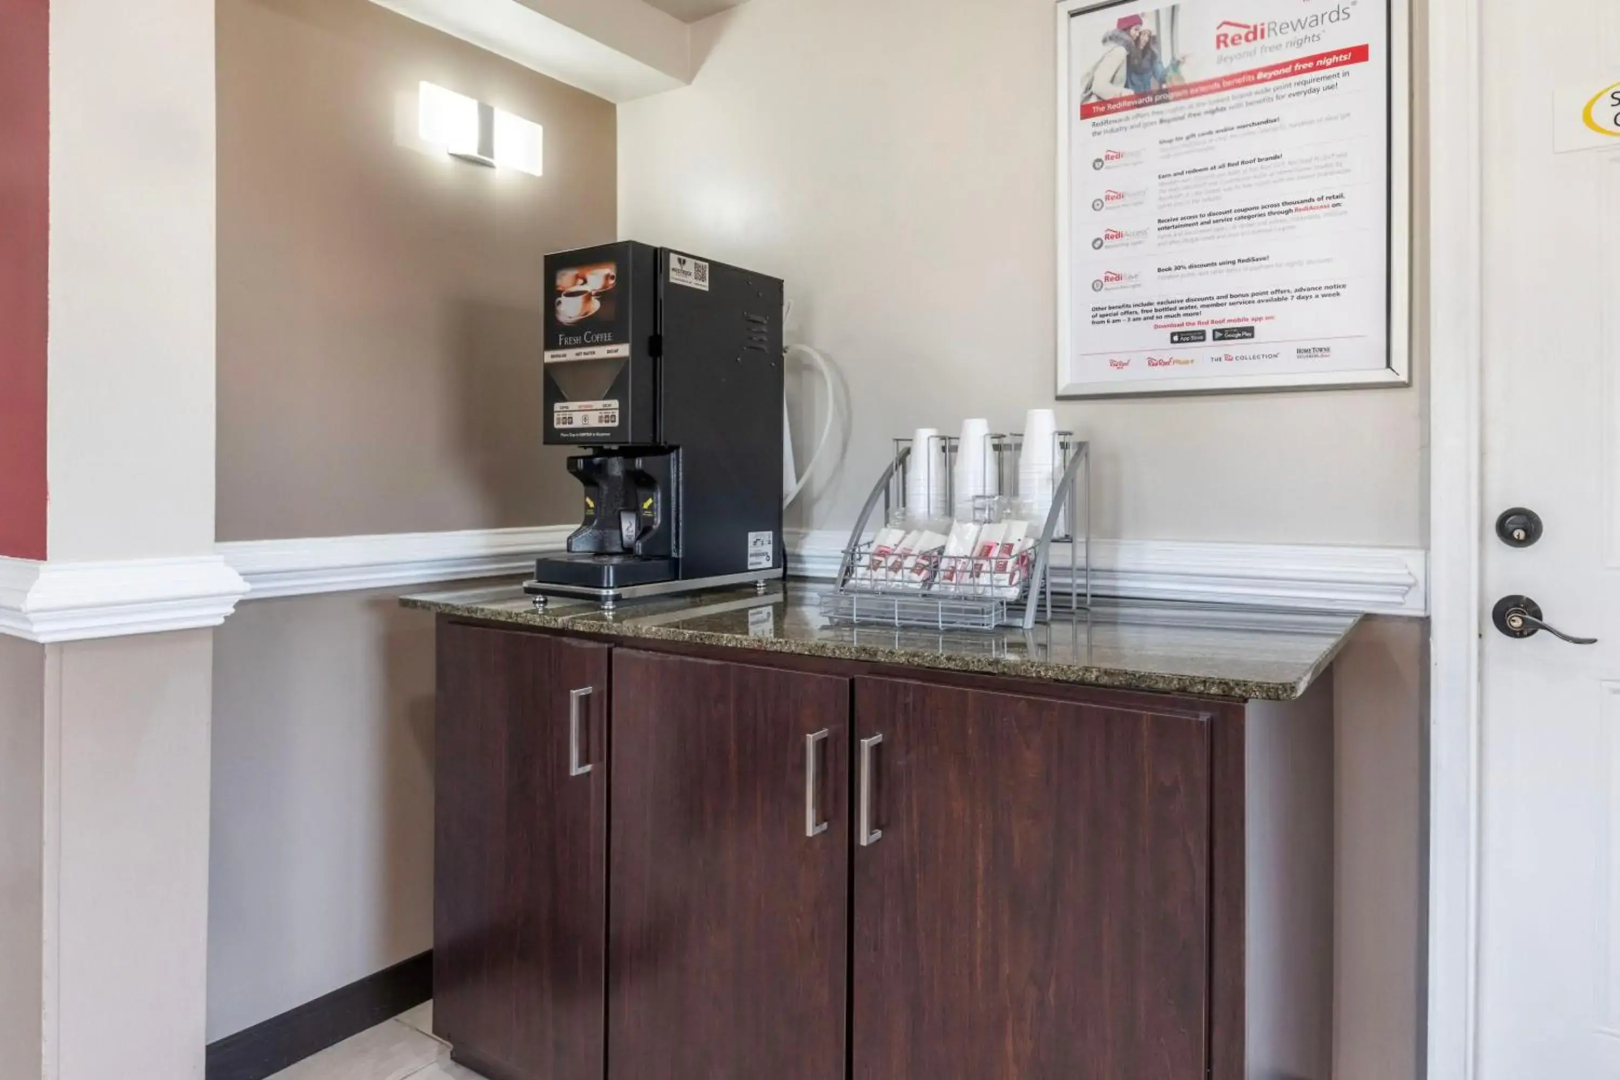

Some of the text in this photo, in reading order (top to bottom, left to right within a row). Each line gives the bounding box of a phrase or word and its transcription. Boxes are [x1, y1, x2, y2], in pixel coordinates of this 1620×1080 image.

[1216, 4, 1350, 50] RediRewards
[1216, 33, 1321, 65] Beyond free nights
[1092, 52, 1352, 114] The RediRewards program extends benefits Beyond free nights!
[1092, 115, 1131, 128] RediRewards
[1132, 112, 1147, 120] offers
[1148, 109, 1164, 117] free
[1165, 105, 1185, 115] nights
[1272, 82, 1292, 93] point
[1294, 73, 1340, 89] requirement
[1103, 124, 1128, 136] industry
[1142, 120, 1157, 129] goes
[1159, 115, 1185, 125] Beyond
[1187, 111, 1202, 119] free
[1203, 106, 1227, 116] nights
[1229, 101, 1244, 110] with
[1245, 96, 1274, 108] benefits
[1275, 92, 1286, 100] for
[1288, 86, 1321, 99] everyday
[1322, 82, 1338, 91] use!
[1185, 167, 1209, 175] redeem
[1240, 158, 1256, 166] Roof
[1257, 153, 1283, 163] brands!
[1157, 216, 1179, 224] Receive
[1207, 208, 1233, 217] discount
[1233, 205, 1260, 214] coupons
[1281, 197, 1315, 207] thousands
[1325, 193, 1345, 201] retail,
[1157, 222, 1199, 232] entertainment
[1212, 216, 1233, 224] service
[1234, 213, 1266, 222] categories
[1267, 208, 1294, 217] through
[1294, 203, 1331, 213] RediAccess
[1188, 261, 1218, 270] discounts
[1218, 259, 1236, 267] using
[1237, 255, 1270, 264] RediSave!
[1099, 310, 1119, 319] special
[1120, 309, 1139, 317] offers,
[1154, 305, 1177, 313] bottled
[1178, 304, 1199, 312] water,
[1200, 301, 1227, 309] member
[1256, 296, 1288, 304] available
[1296, 294, 1313, 302] days
[1108, 303, 1132, 311] benefits
[1132, 301, 1155, 309] include:
[1156, 298, 1185, 306] exclusive
[1185, 295, 1215, 303] discounts
[1251, 290, 1269, 298] point
[1270, 287, 1293, 296] offers,
[1293, 285, 1323, 293] advance
[1154, 322, 1185, 330] Download
[1210, 317, 1226, 325] Roof
[1226, 316, 1249, 324] mobile
[1224, 331, 1241, 339] Google
[1242, 330, 1252, 338] Play
[1235, 353, 1279, 361] COLLECTION
